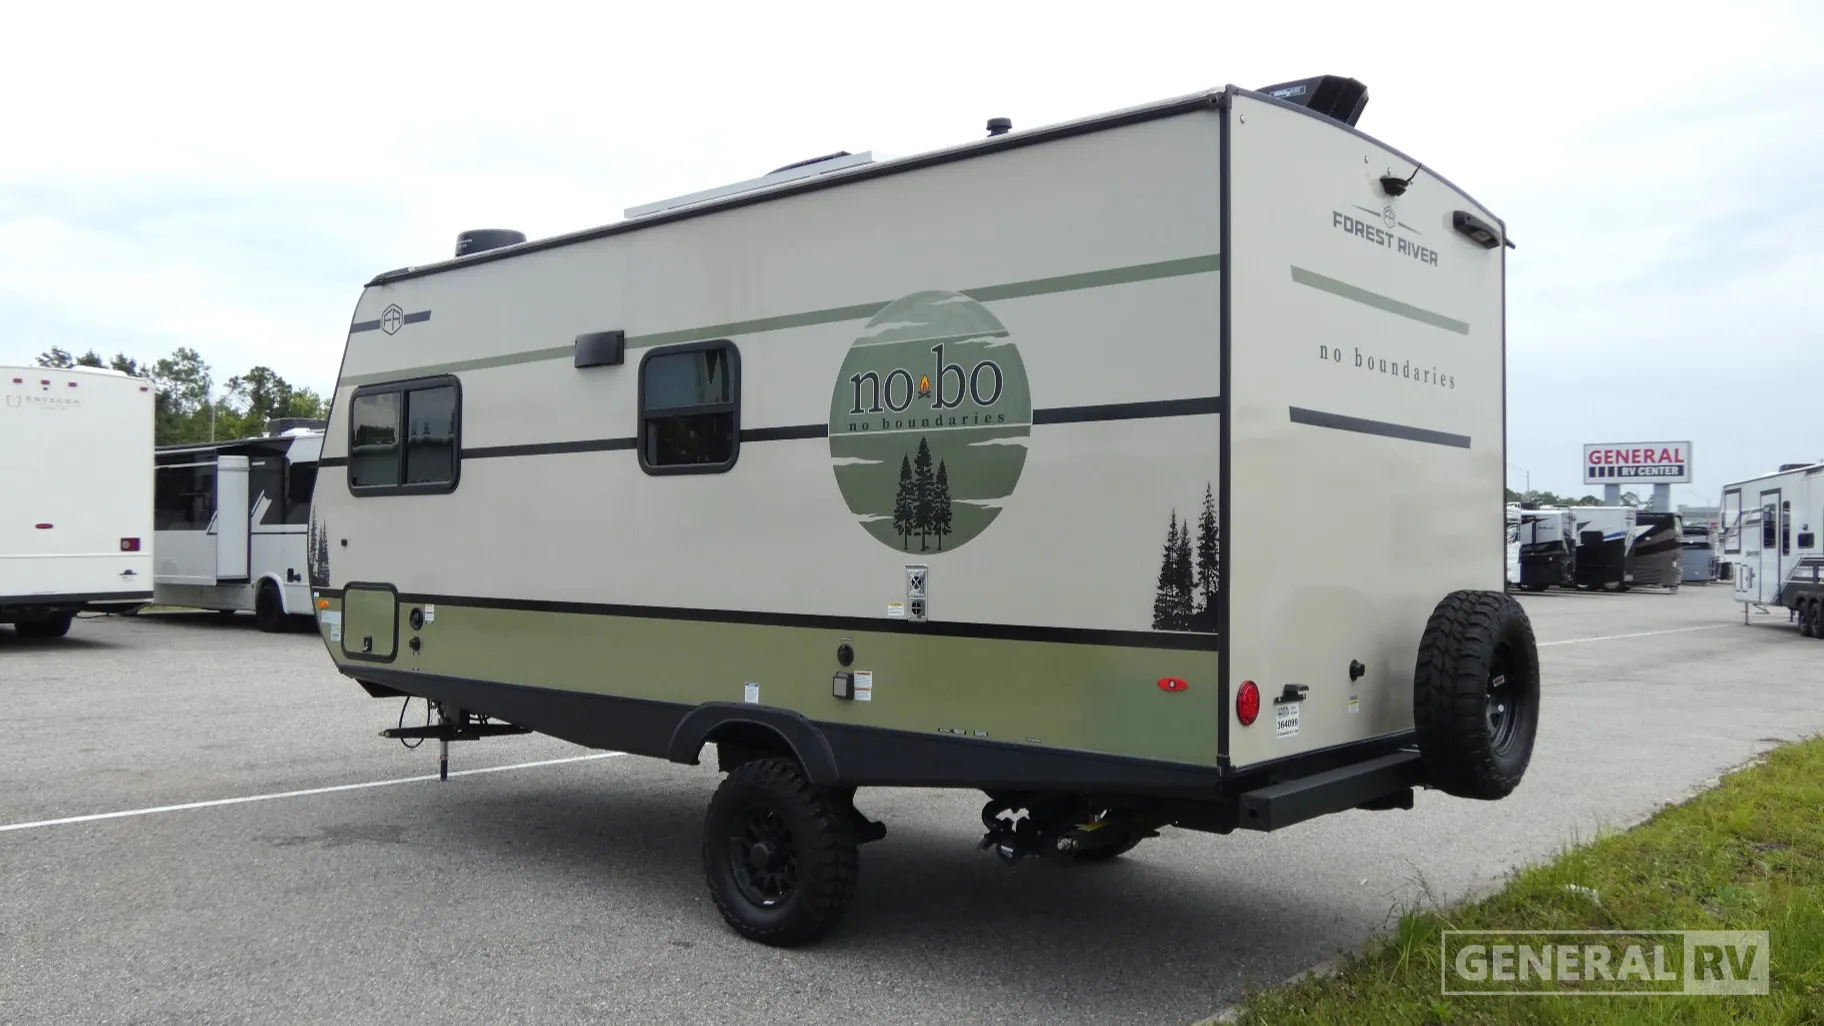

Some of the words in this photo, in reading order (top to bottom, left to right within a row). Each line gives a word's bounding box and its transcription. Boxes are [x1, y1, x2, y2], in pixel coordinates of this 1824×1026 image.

[1333, 211, 1393, 248] FOREST
[1398, 237, 1438, 267] RIVER
[1320, 344, 1341, 363] no
[1355, 347, 1455, 389] boundaries
[849, 421, 870, 431] no
[882, 411, 1005, 429] boundaries
[1589, 448, 1684, 464] GENERAL
[1622, 466, 1636, 476] RV
[1637, 466, 1679, 475] CENTER
